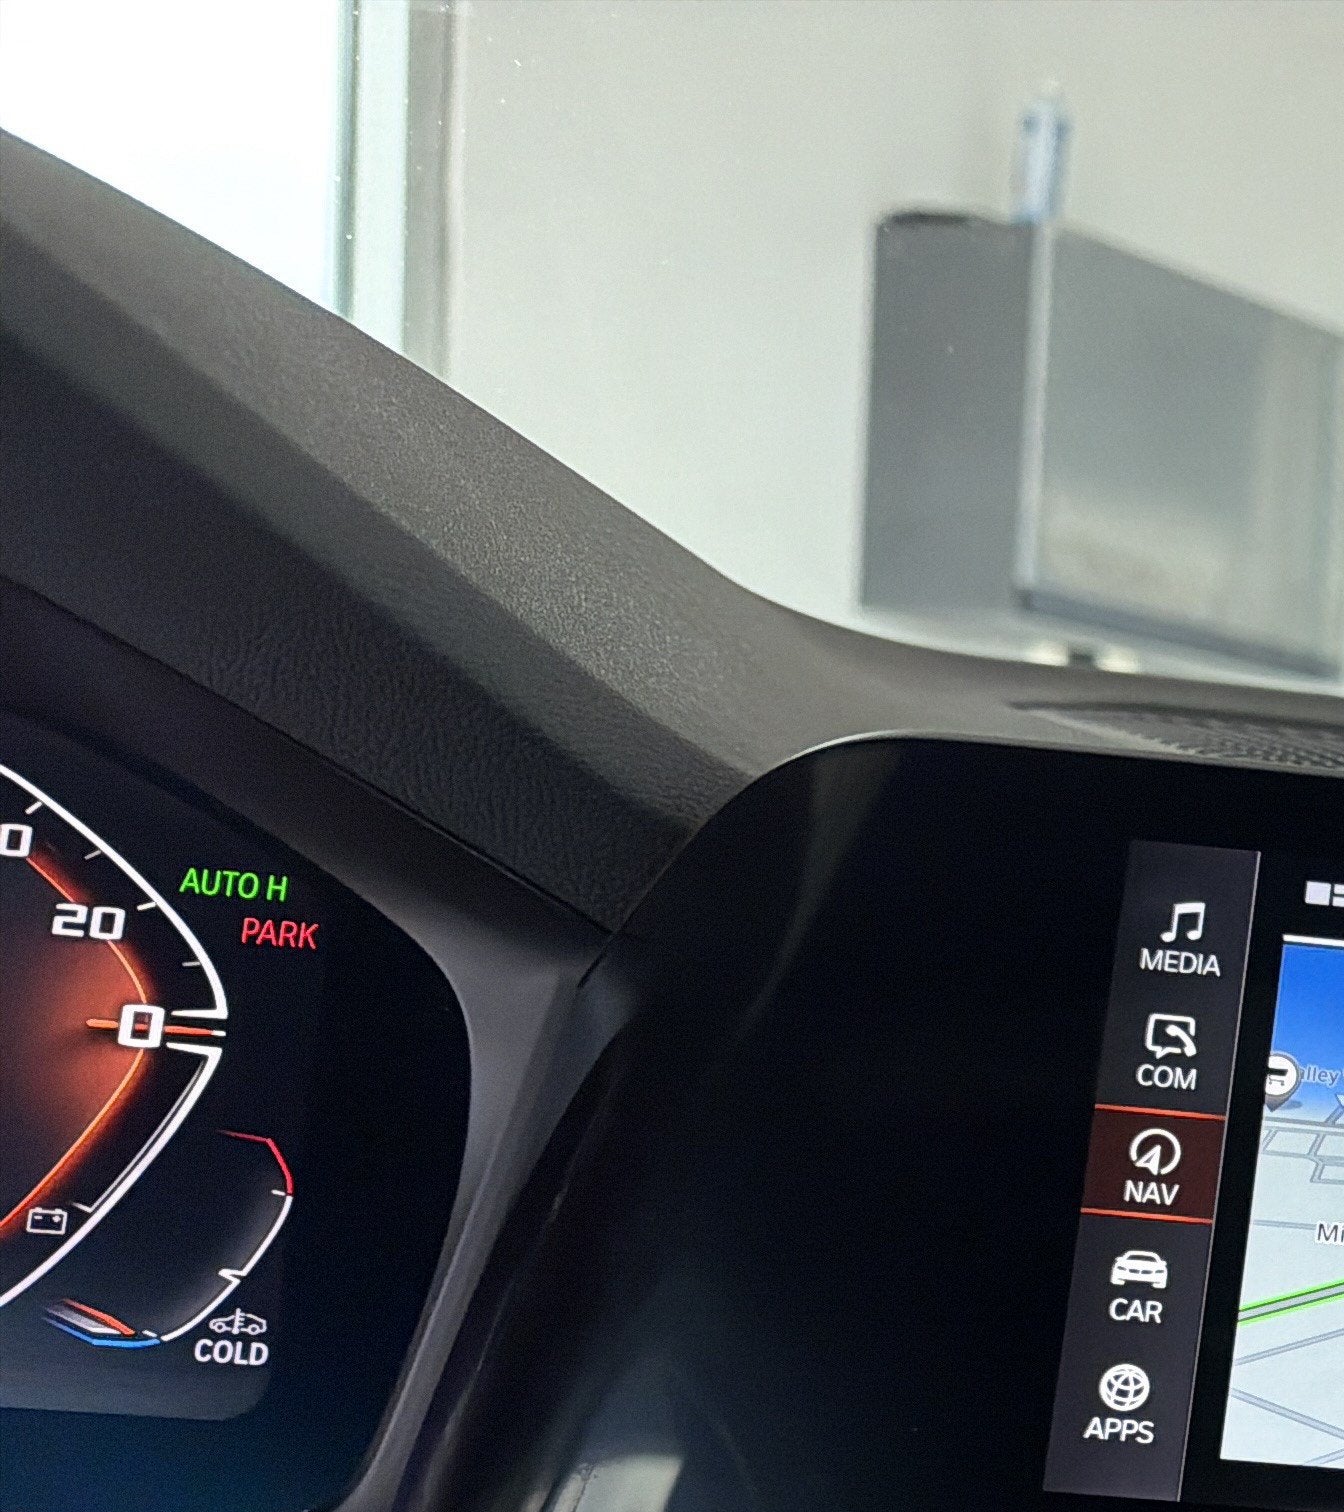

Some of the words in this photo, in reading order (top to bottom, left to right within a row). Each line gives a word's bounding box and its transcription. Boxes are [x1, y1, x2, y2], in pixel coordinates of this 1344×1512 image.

[179, 866, 259, 899] AUTO
[267, 876, 288, 900] H
[52, 903, 126, 940] 20
[241, 916, 319, 949] PARK
[1139, 948, 1222, 977] MEDIA
[117, 1004, 165, 1048] 0
[1136, 1064, 1198, 1091] COM
[1123, 1180, 1179, 1206] NAV
[1108, 1299, 1163, 1325] CAR
[194, 1337, 269, 1366] COLD
[1083, 1417, 1155, 1445] APPS
